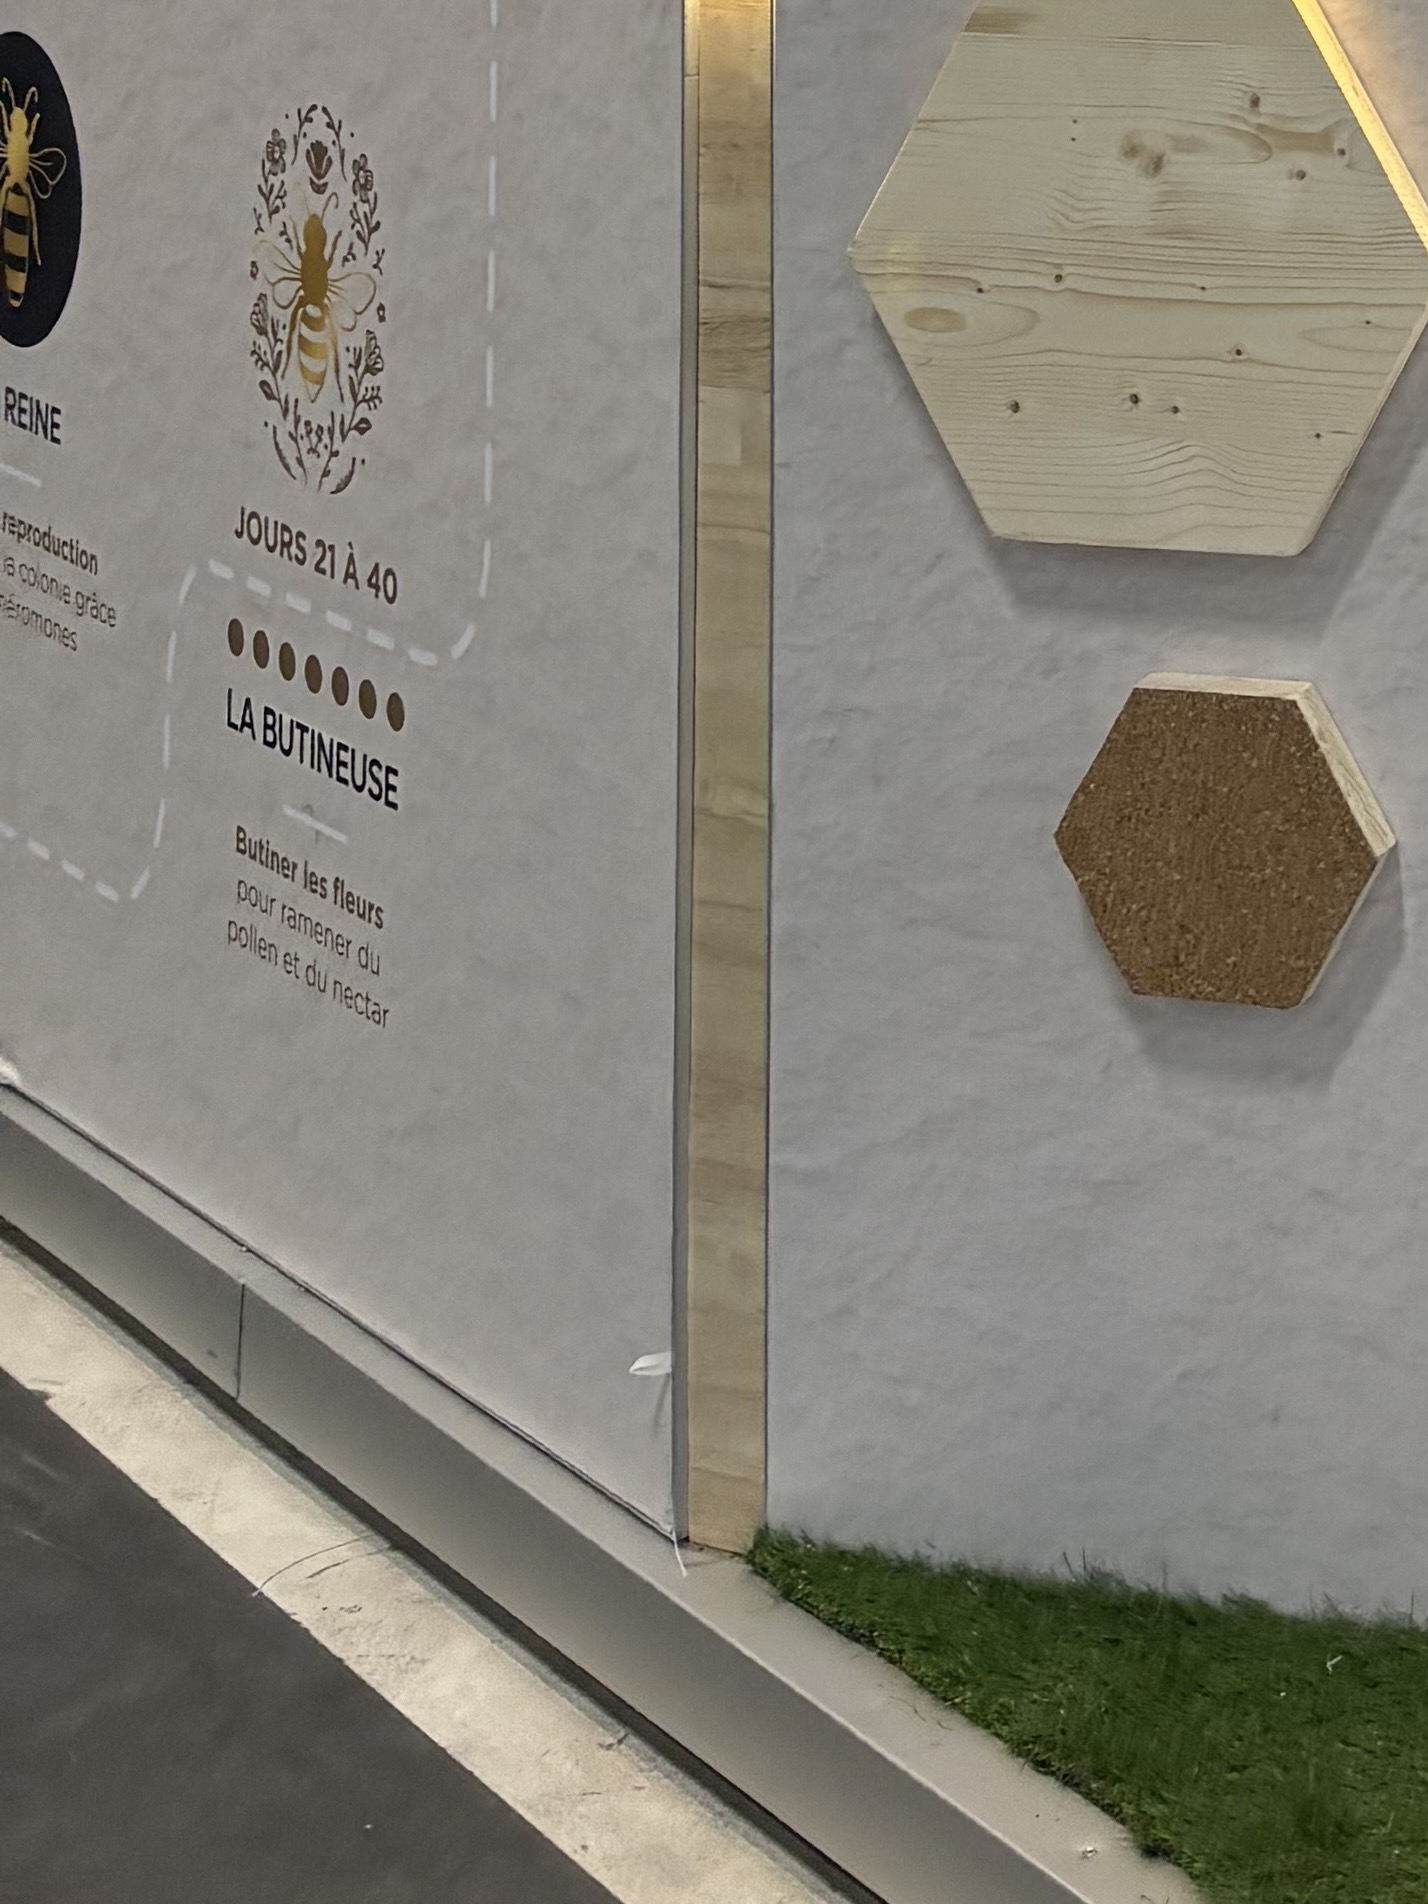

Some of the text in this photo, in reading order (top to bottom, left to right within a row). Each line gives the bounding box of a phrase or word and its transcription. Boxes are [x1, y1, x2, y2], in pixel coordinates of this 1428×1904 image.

[4, 385, 62, 446] REINE
[2, 511, 98, 577] reproduction
[234, 505, 398, 605] JOURS 21 À 40
[18, 561, 72, 606] colonie
[75, 590, 117, 629] grâce
[226, 687, 399, 812] LA BUTINEUSE
[236, 824, 384, 930] Butiner les fleurs
[227, 920, 389, 1029] pollen et du nectar
[237, 879, 380, 977] pour ramener du
